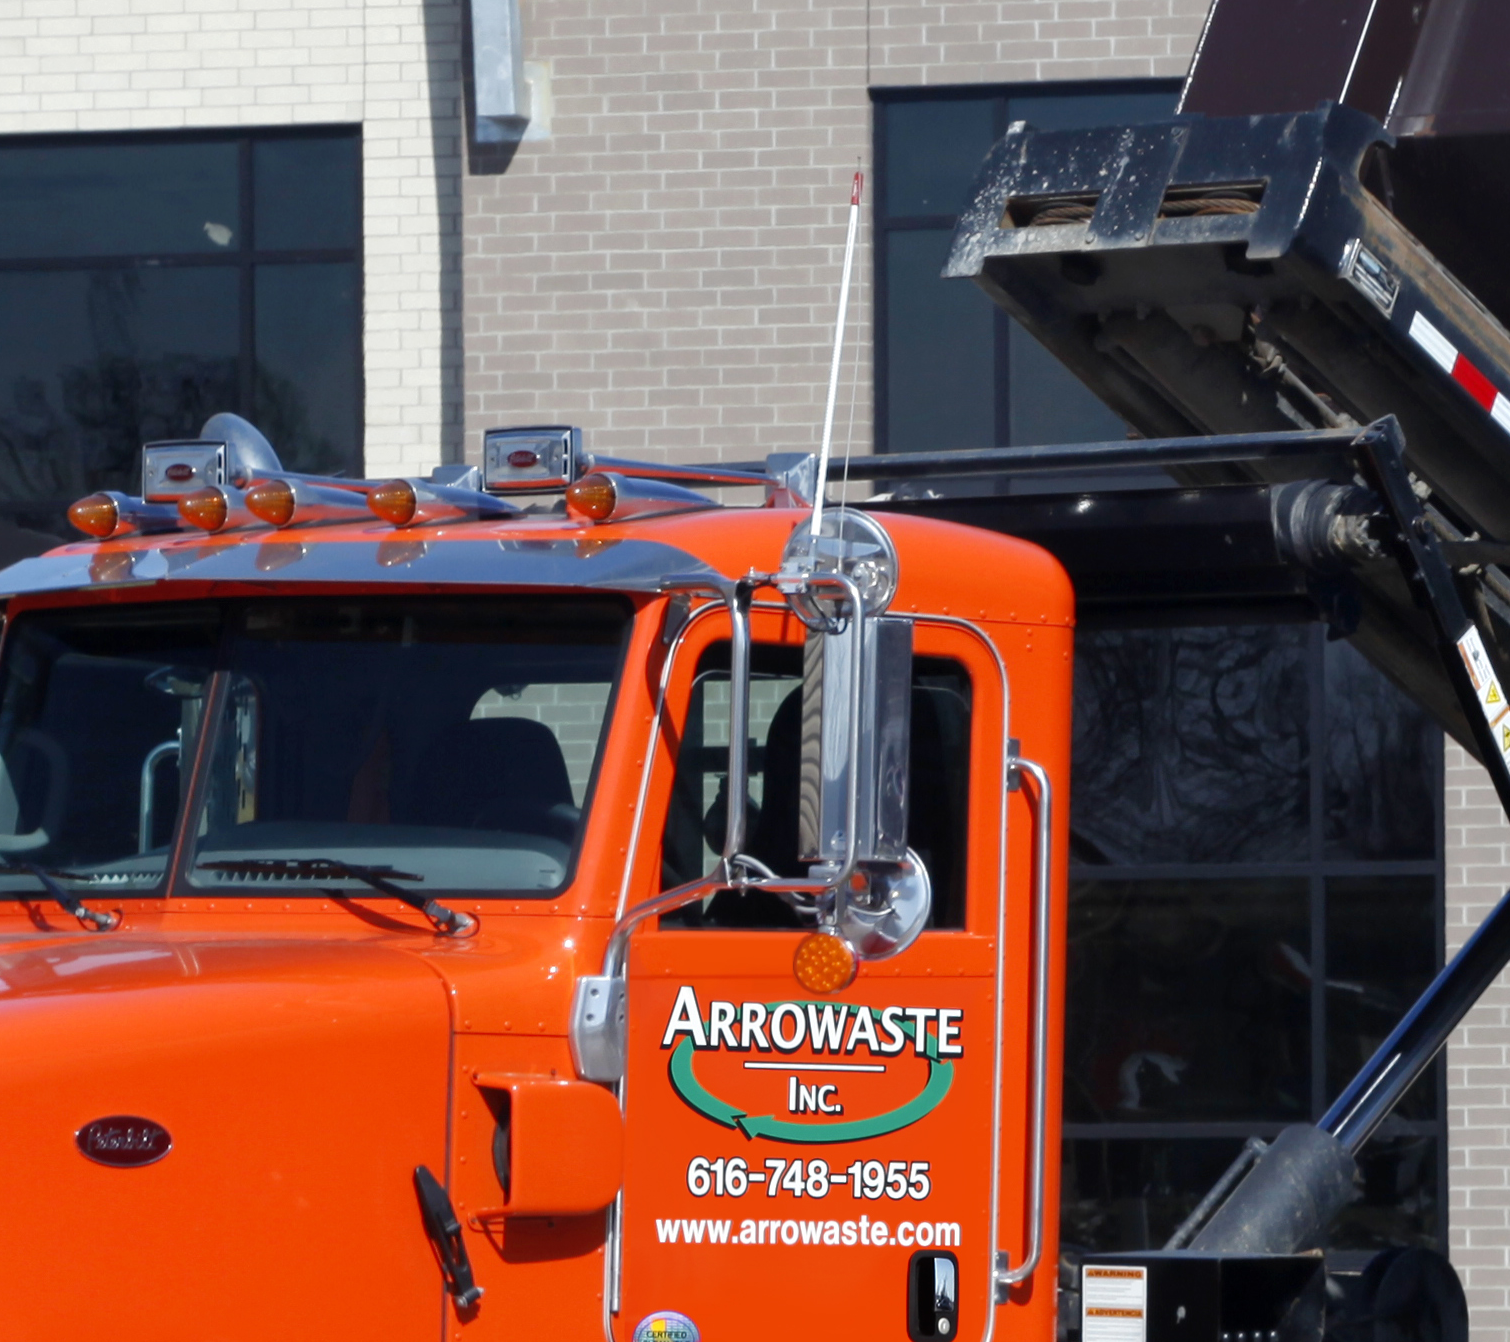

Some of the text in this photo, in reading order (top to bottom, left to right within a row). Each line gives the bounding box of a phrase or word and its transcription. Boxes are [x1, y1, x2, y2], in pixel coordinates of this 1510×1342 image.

[660, 985, 964, 1058] ARROWASTE
[87, 1123, 164, 1151] Peterbilt
[686, 1156, 931, 1200] 616-748-1955
[655, 1214, 961, 1246] www.arrowaste.com
[1094, 1270, 1142, 1278] WARNING
[646, 1331, 687, 1339] CERTIFIED
